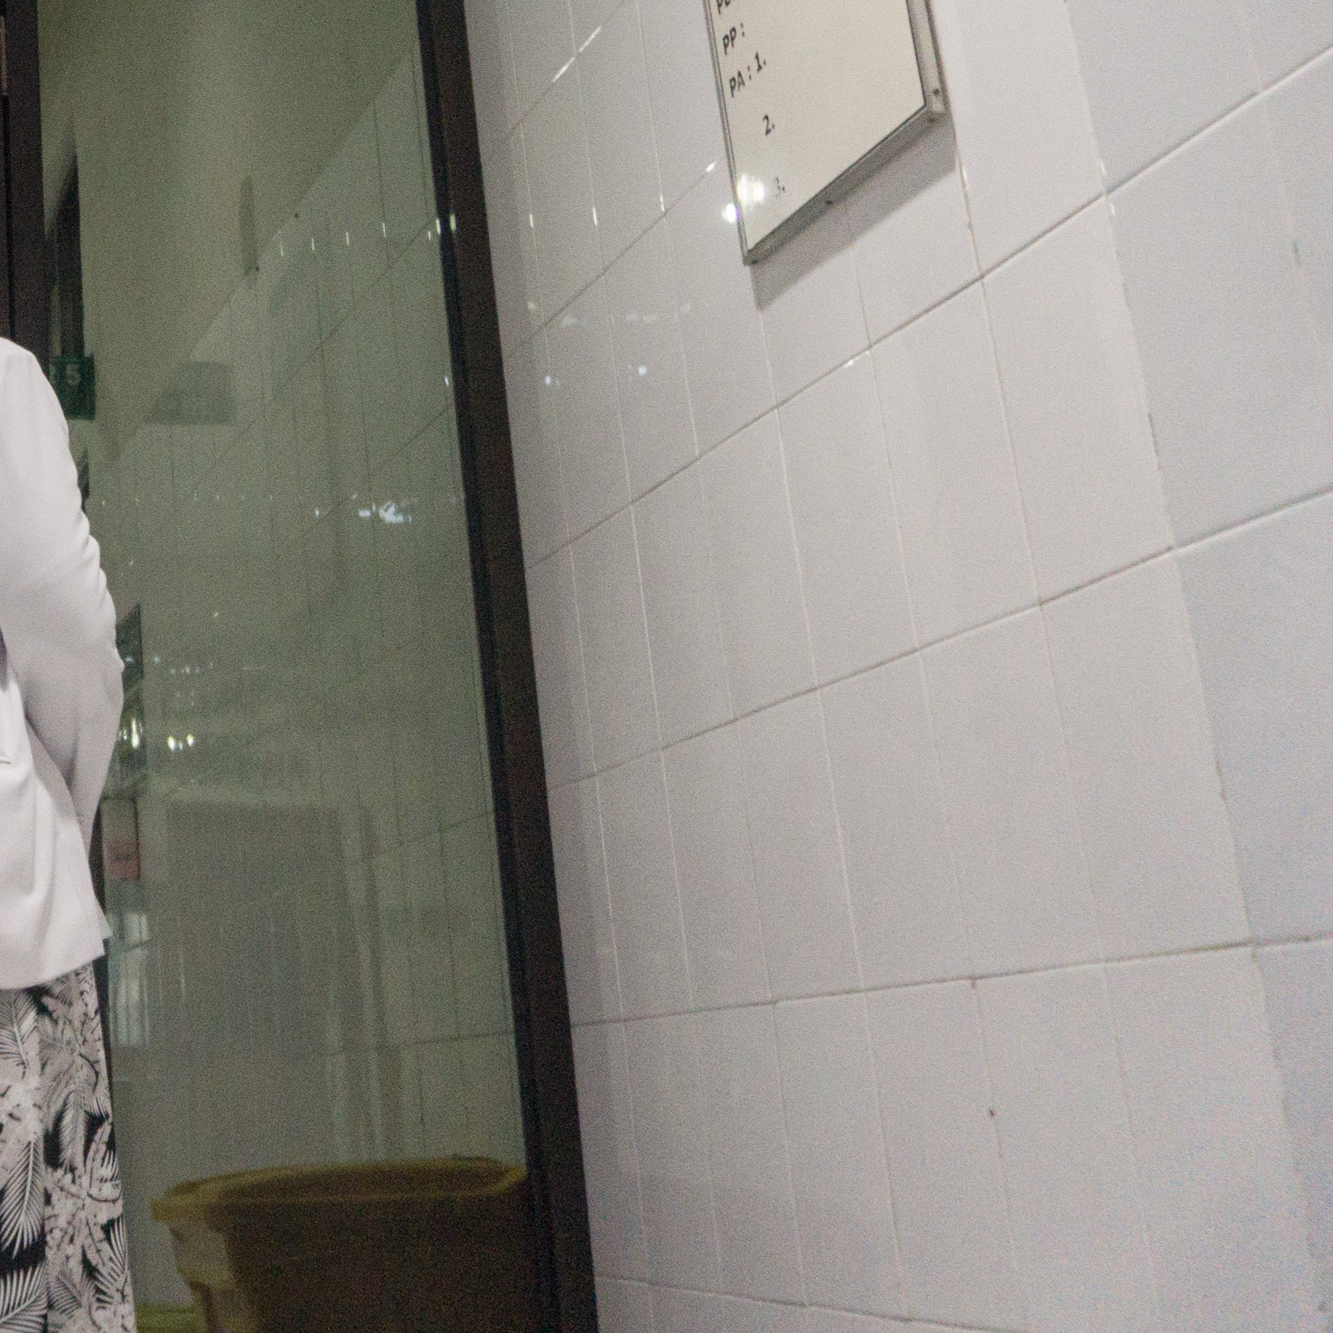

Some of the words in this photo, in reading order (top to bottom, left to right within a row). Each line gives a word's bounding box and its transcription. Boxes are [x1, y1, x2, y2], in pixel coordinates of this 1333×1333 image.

[722, 26, 737, 56] PP
[729, 70, 746, 98] PA
[754, 51, 767, 72] 1.
[762, 113, 775, 137] 2.
